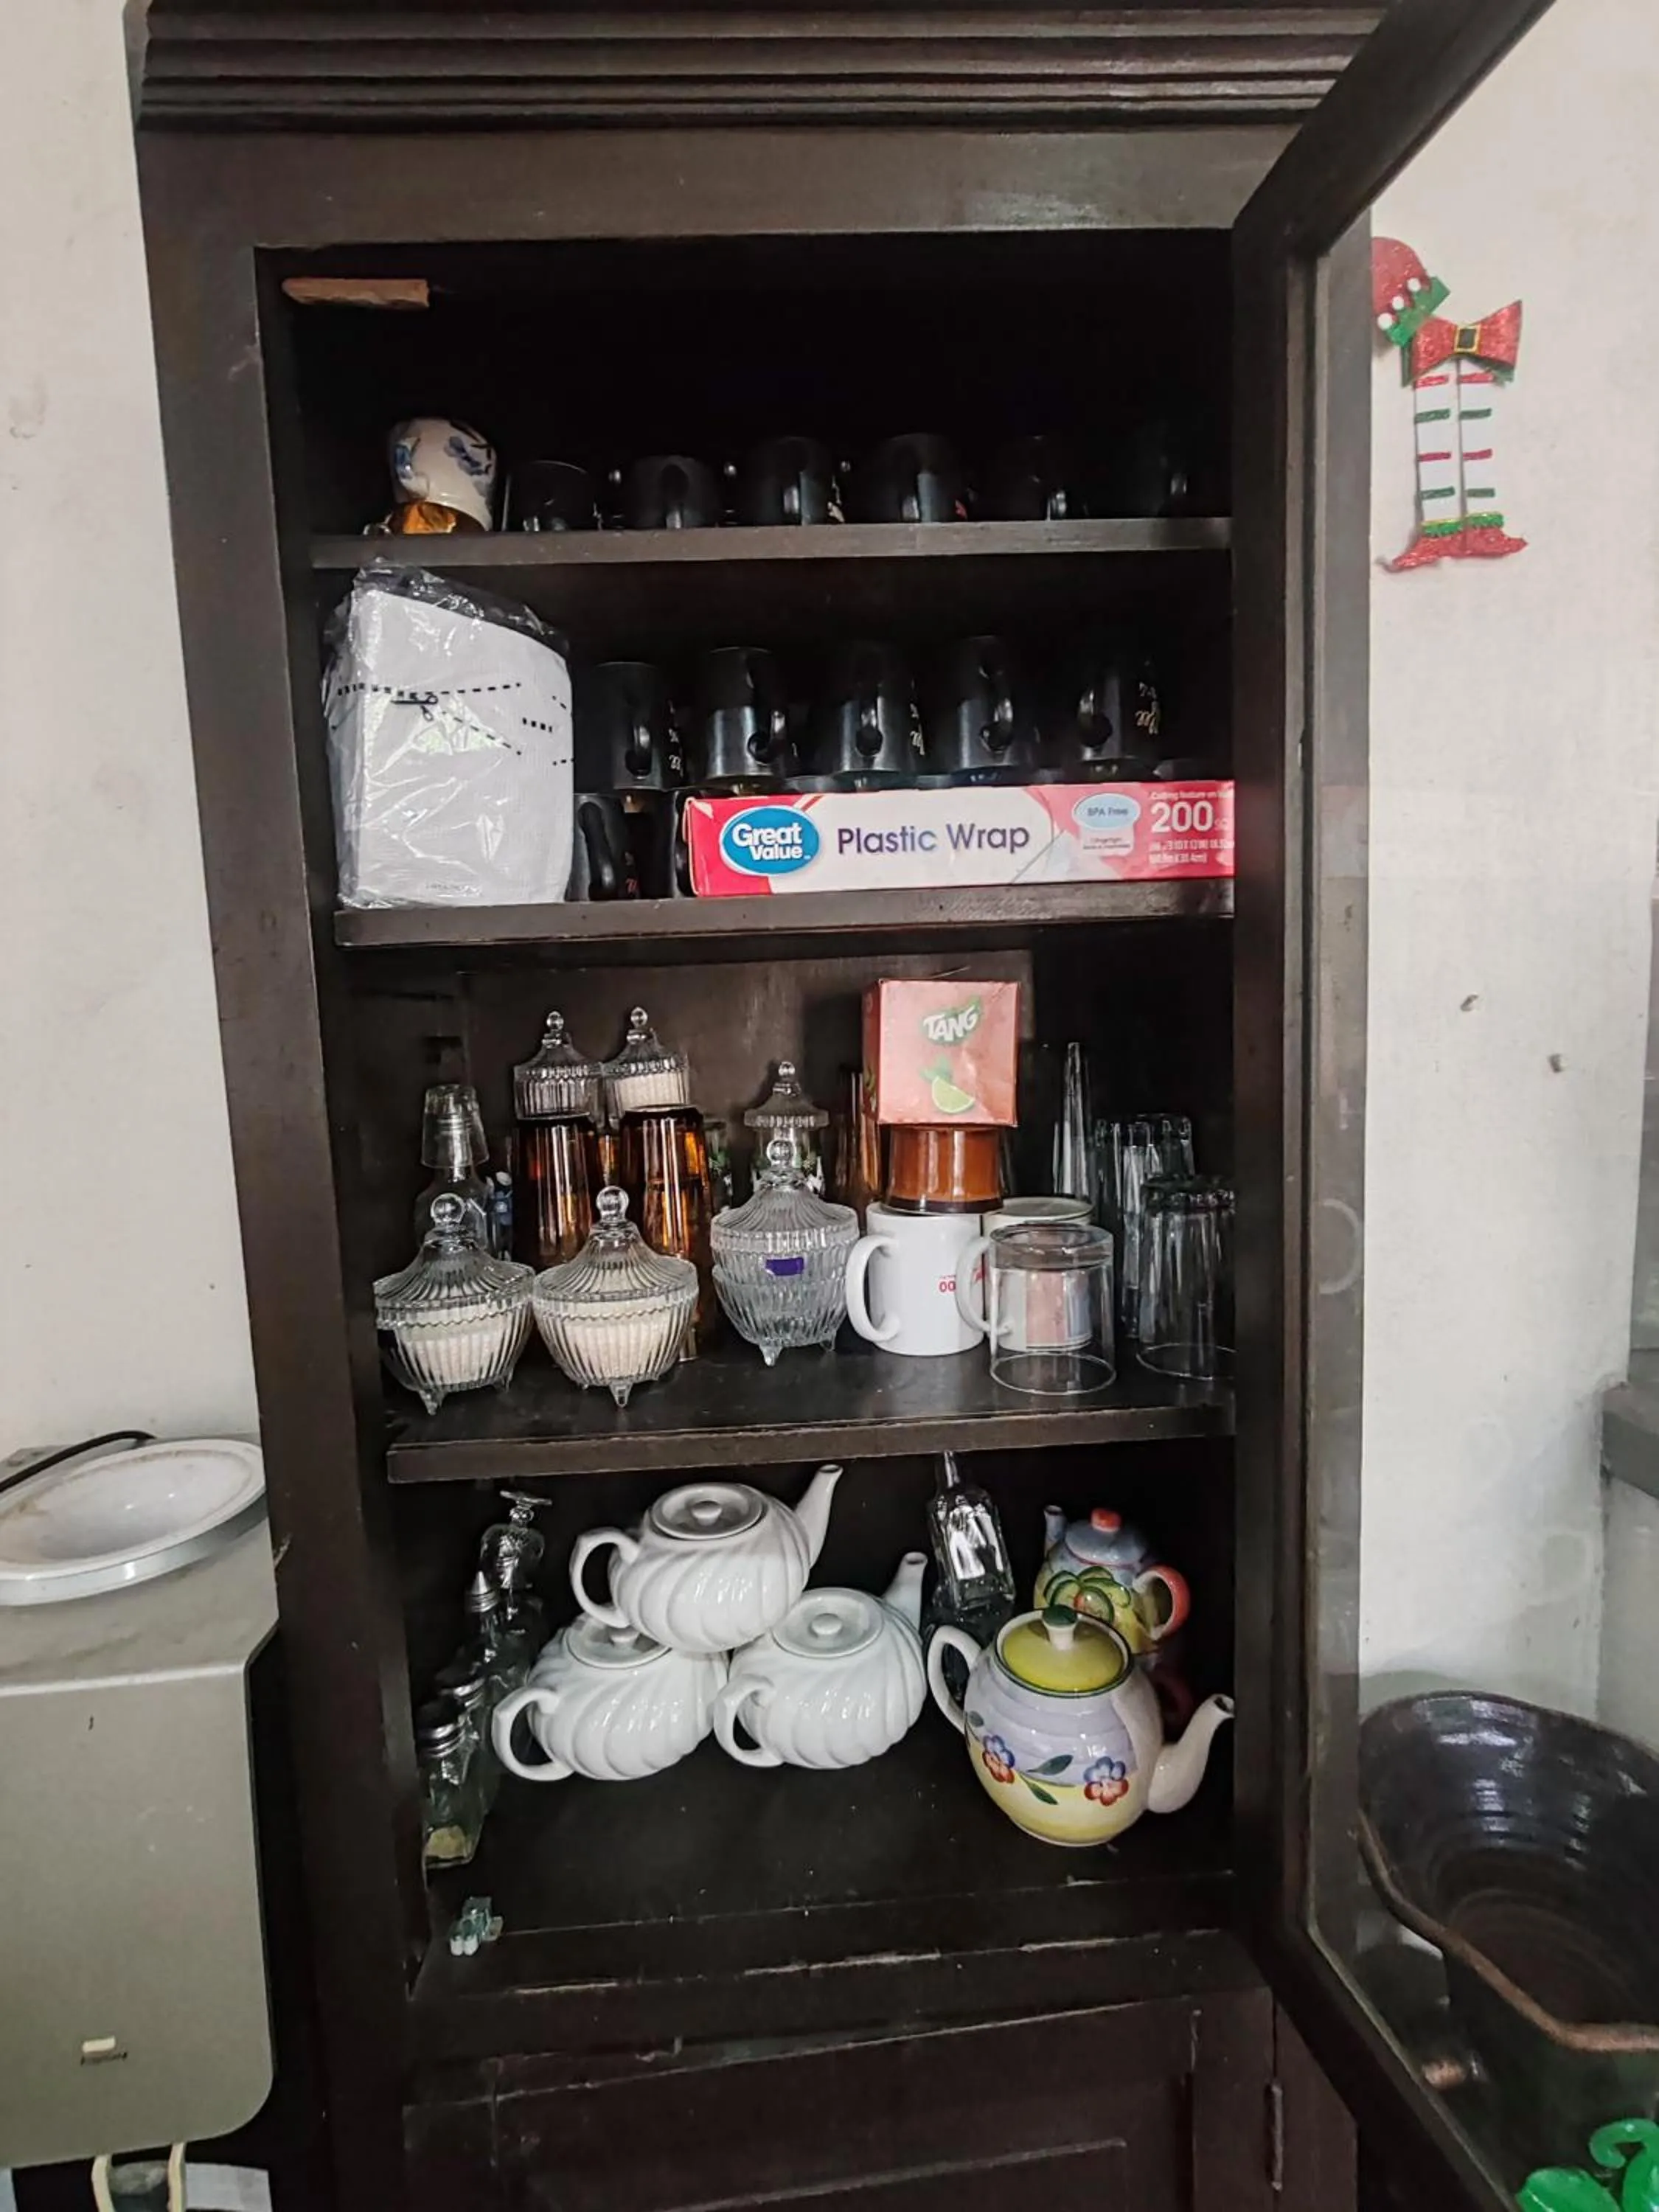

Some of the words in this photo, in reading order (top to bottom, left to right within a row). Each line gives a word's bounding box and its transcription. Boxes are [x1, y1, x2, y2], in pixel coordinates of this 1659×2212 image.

[1151, 801, 1214, 834] 200
[731, 822, 802, 847] Great
[837, 826, 937, 855] Plastic
[946, 823, 1030, 855] Wrap
[749, 846, 803, 860] Value
[922, 1004, 978, 1042] TANG
